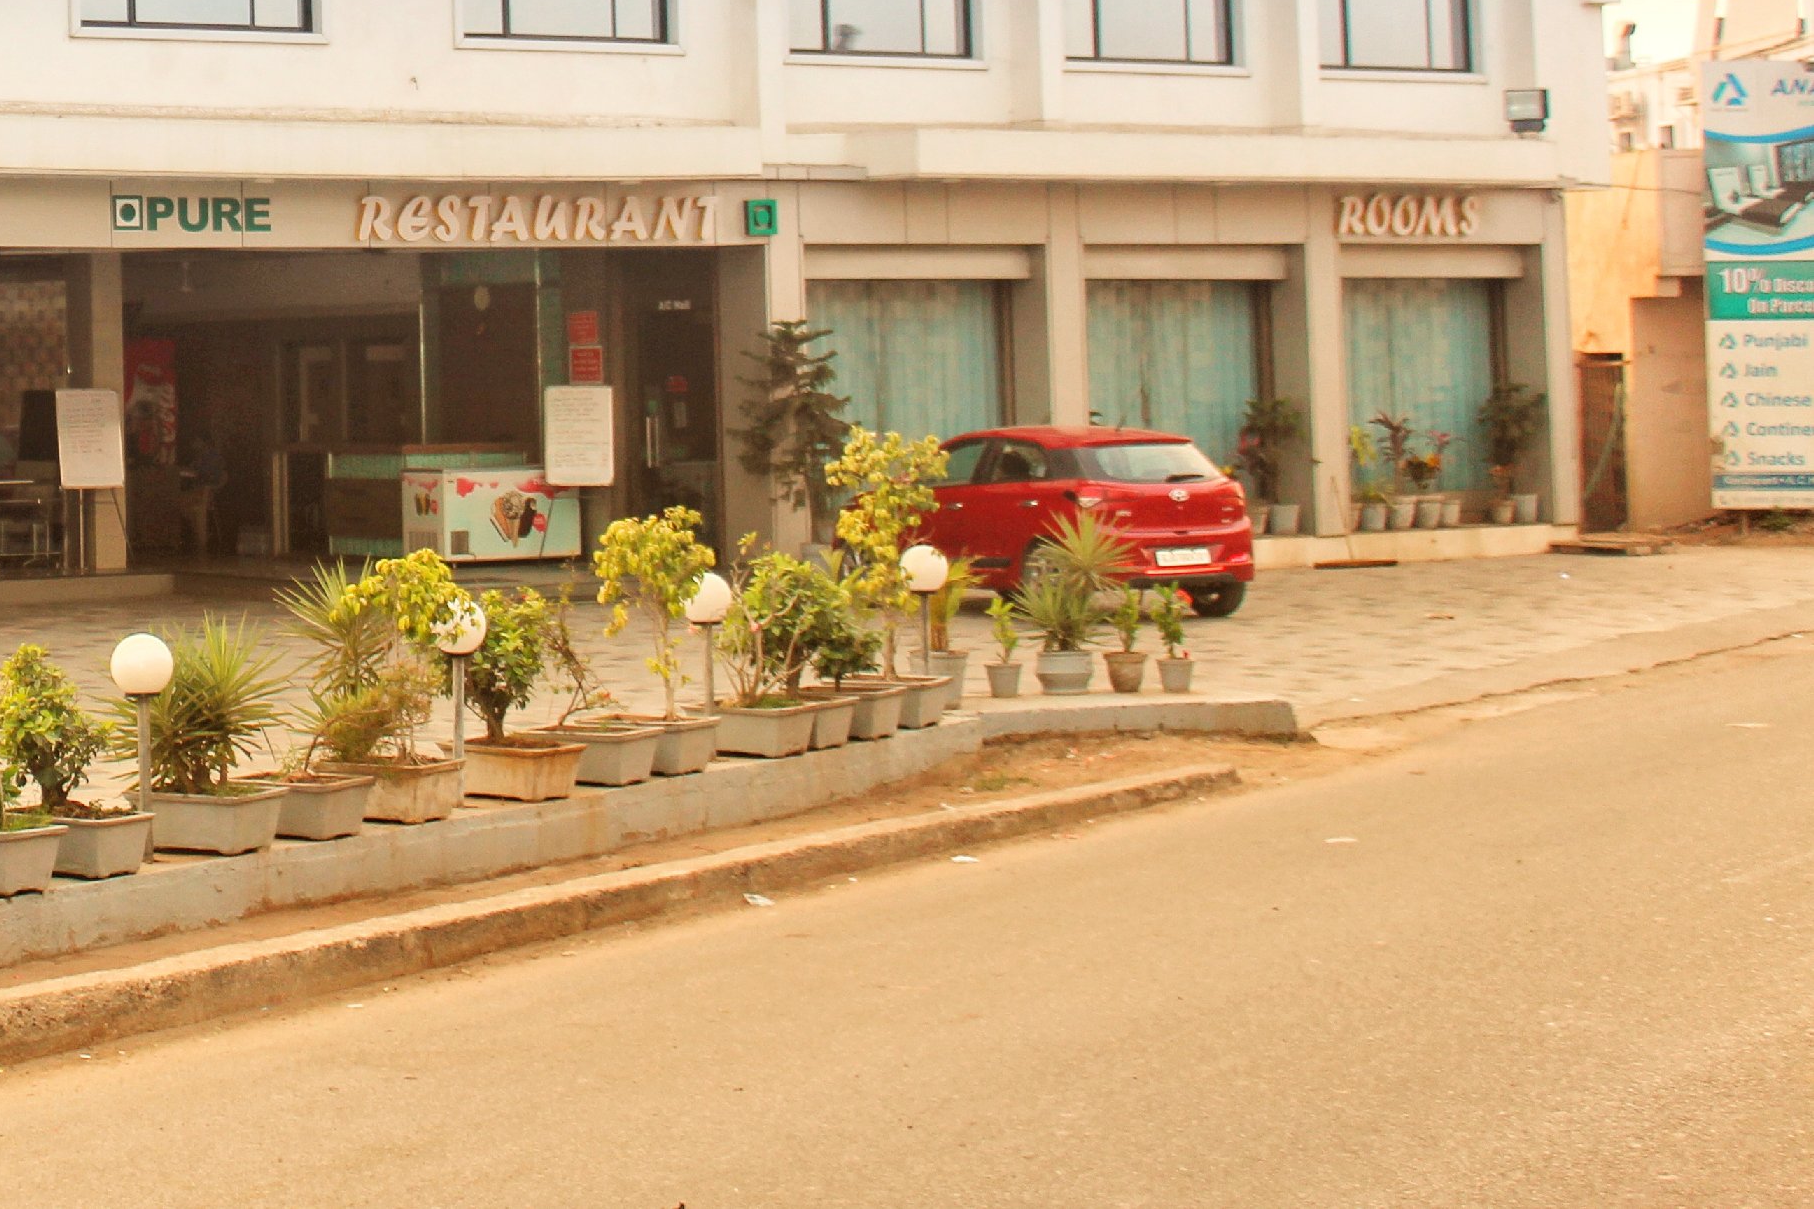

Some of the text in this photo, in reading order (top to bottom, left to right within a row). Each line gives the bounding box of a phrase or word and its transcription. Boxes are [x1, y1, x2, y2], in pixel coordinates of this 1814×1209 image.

[1770, 79, 1814, 96] AN
[146, 194, 718, 242] PURE RESTAURANT
[1338, 194, 1478, 237] ROOMS
[1717, 268, 1772, 294] 10%
[1770, 298, 1814, 314] Parce
[1744, 334, 1808, 350] Punjabi
[1745, 363, 1777, 377] Jain
[1745, 392, 1812, 407] Chinese
[1748, 452, 1805, 465] Snacks
